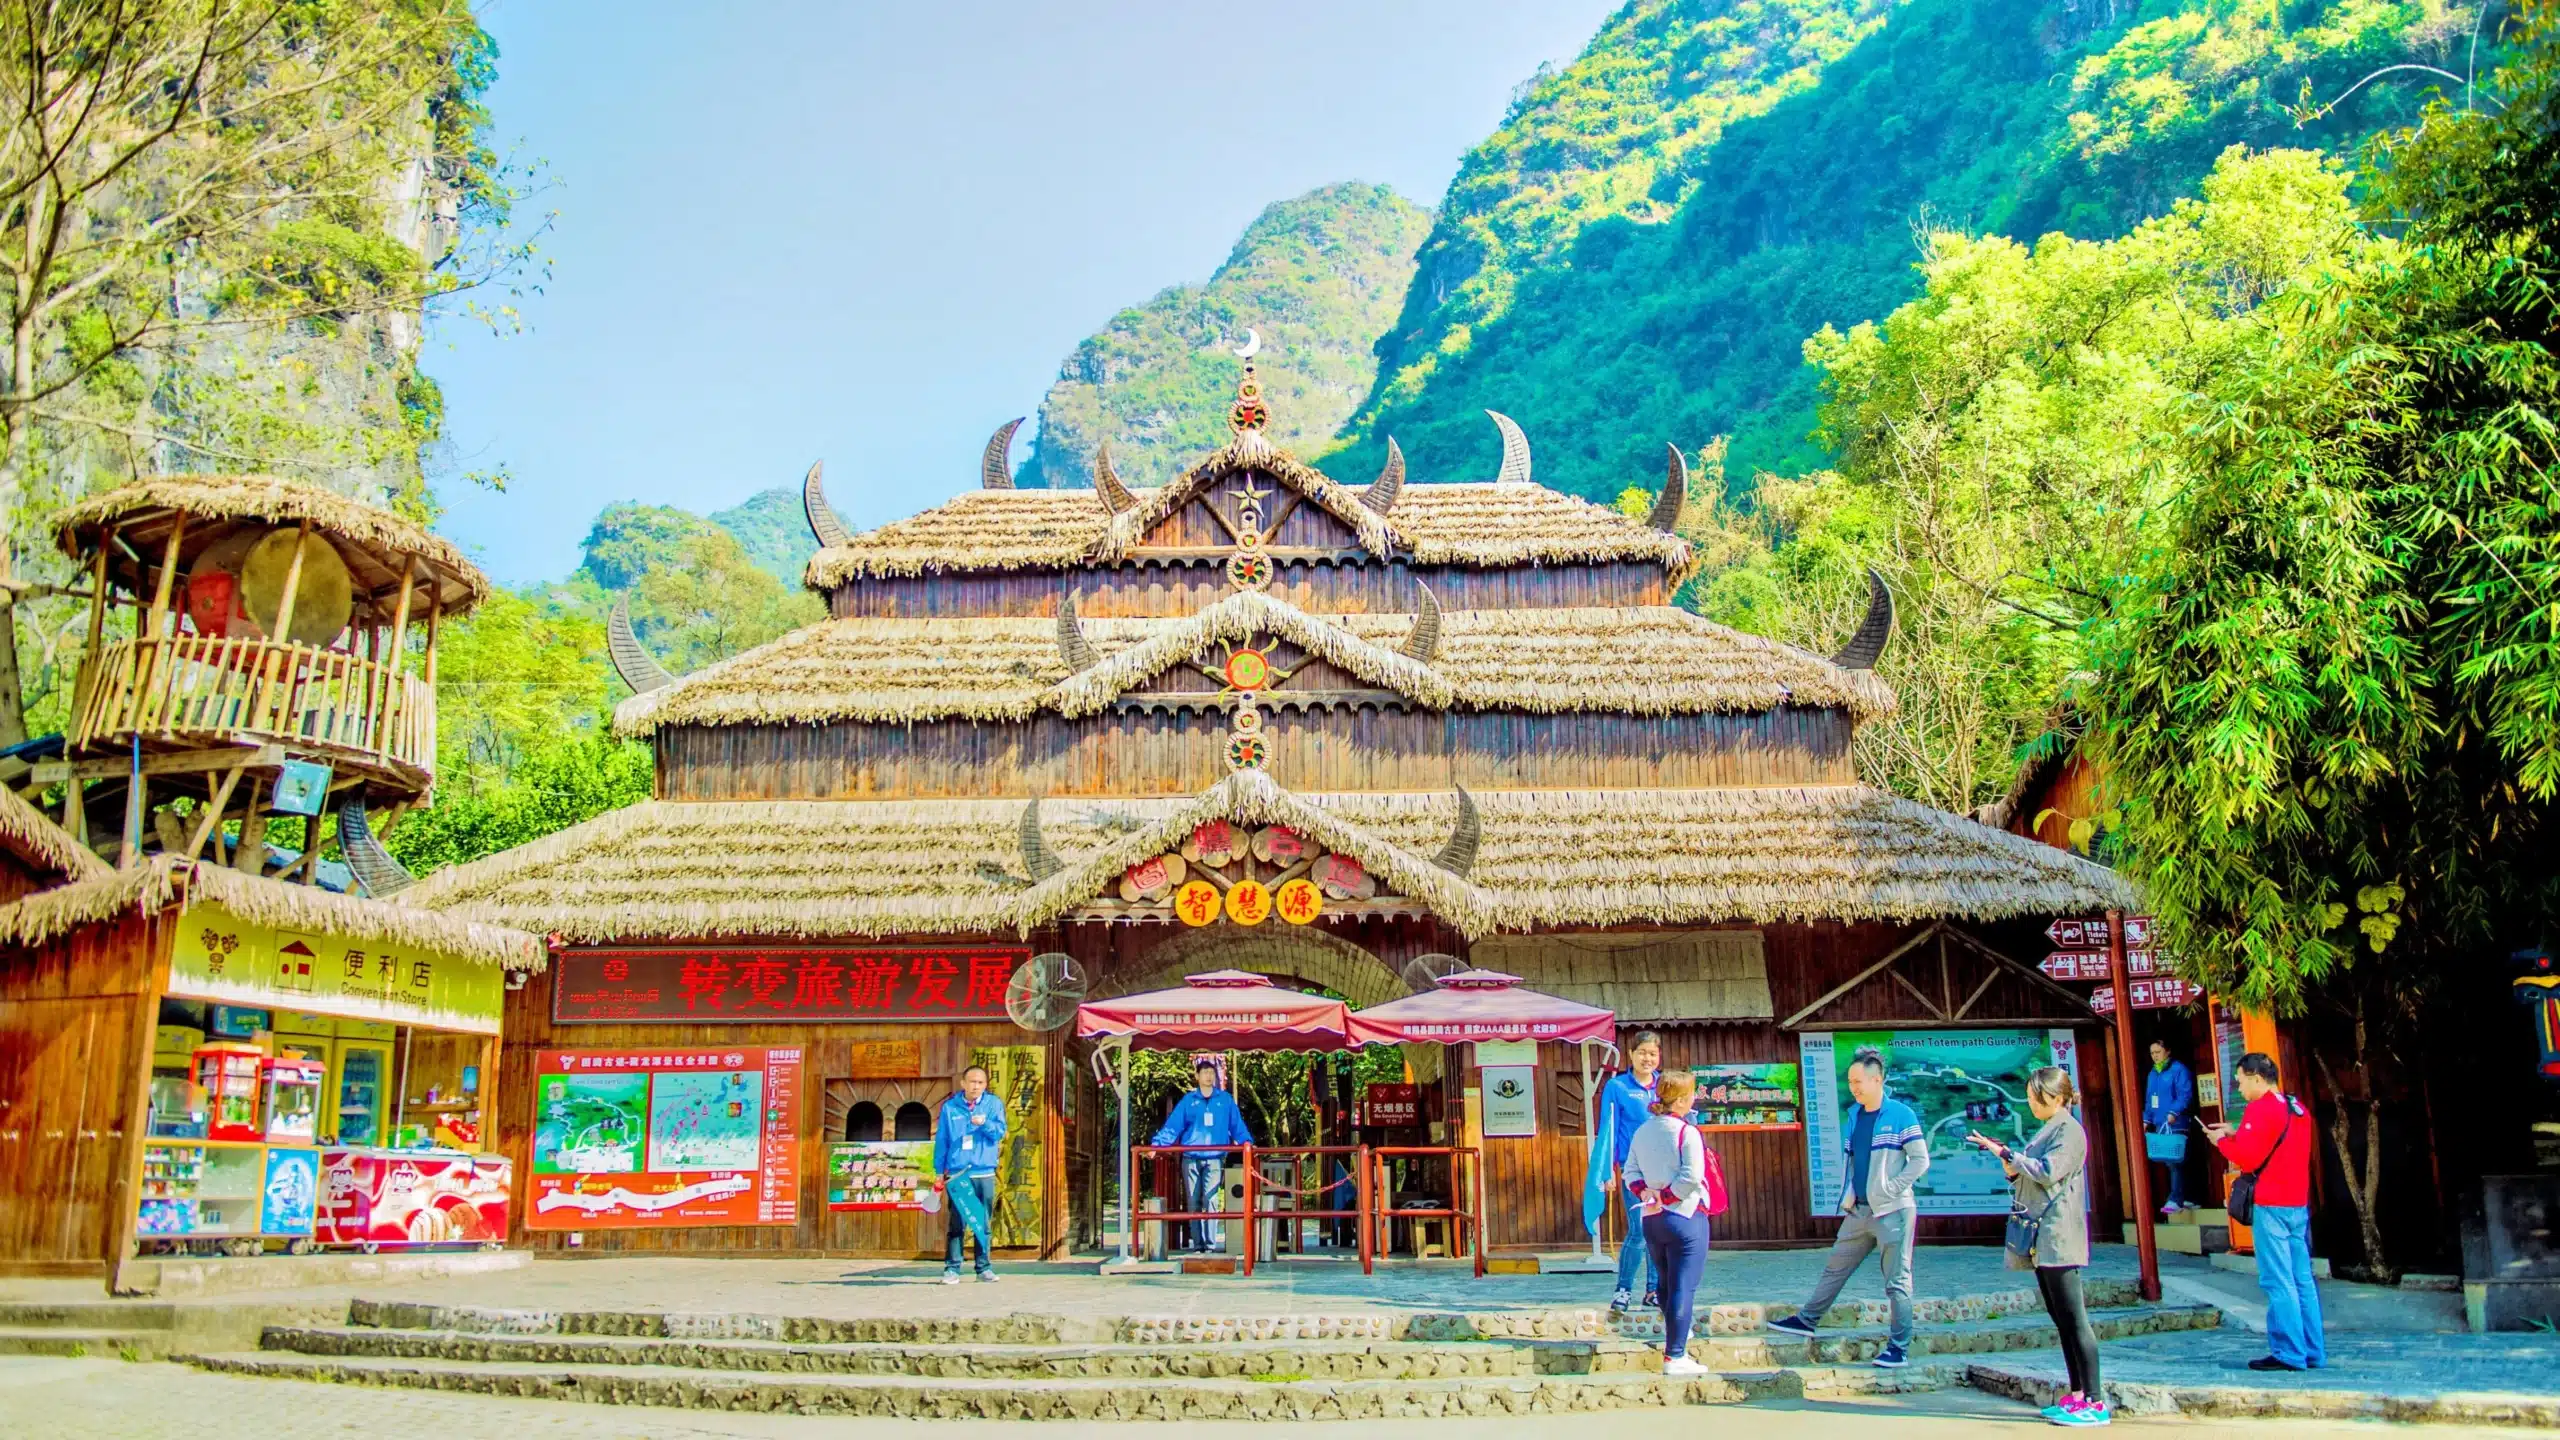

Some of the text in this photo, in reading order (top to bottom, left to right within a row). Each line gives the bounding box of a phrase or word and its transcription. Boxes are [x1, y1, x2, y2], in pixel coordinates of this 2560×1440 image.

[1182, 885, 1314, 922] 智慧源
[344, 948, 431, 988] 便利店
[677, 955, 1014, 1011] 转变旅游发展
[340, 981, 427, 1006] Convenient Store
[1887, 1036, 2041, 1049] Ancient Totem path Guide Map
[1373, 1103, 1415, 1113] 无烟景区
